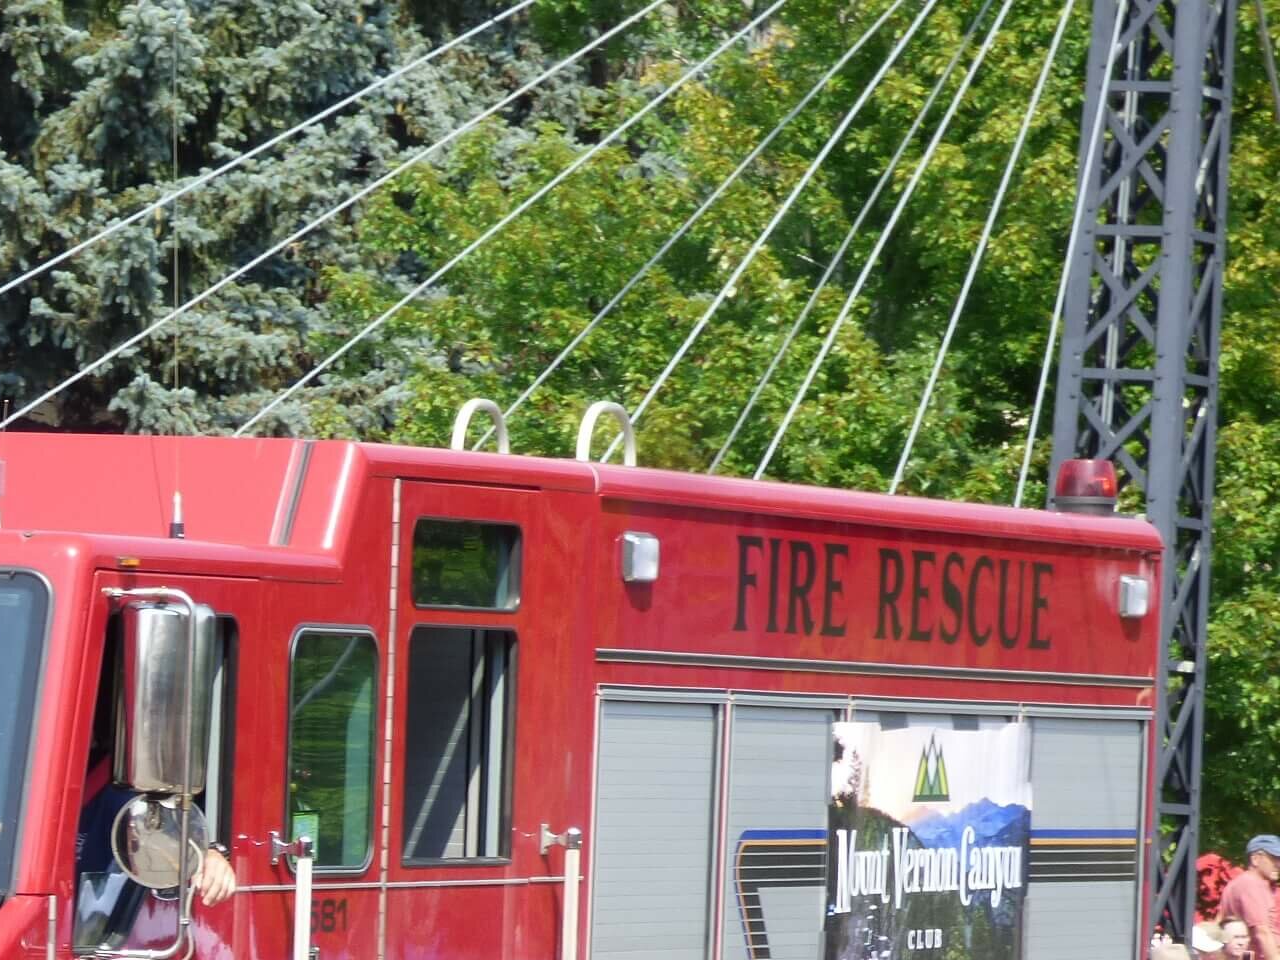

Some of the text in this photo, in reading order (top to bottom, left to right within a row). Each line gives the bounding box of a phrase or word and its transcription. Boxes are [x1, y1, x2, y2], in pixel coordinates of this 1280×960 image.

[733, 535, 1054, 650] FIRE RESCUE
[834, 825, 1023, 914] Mount Vernon Canyon
[907, 929, 943, 950] CLUB
